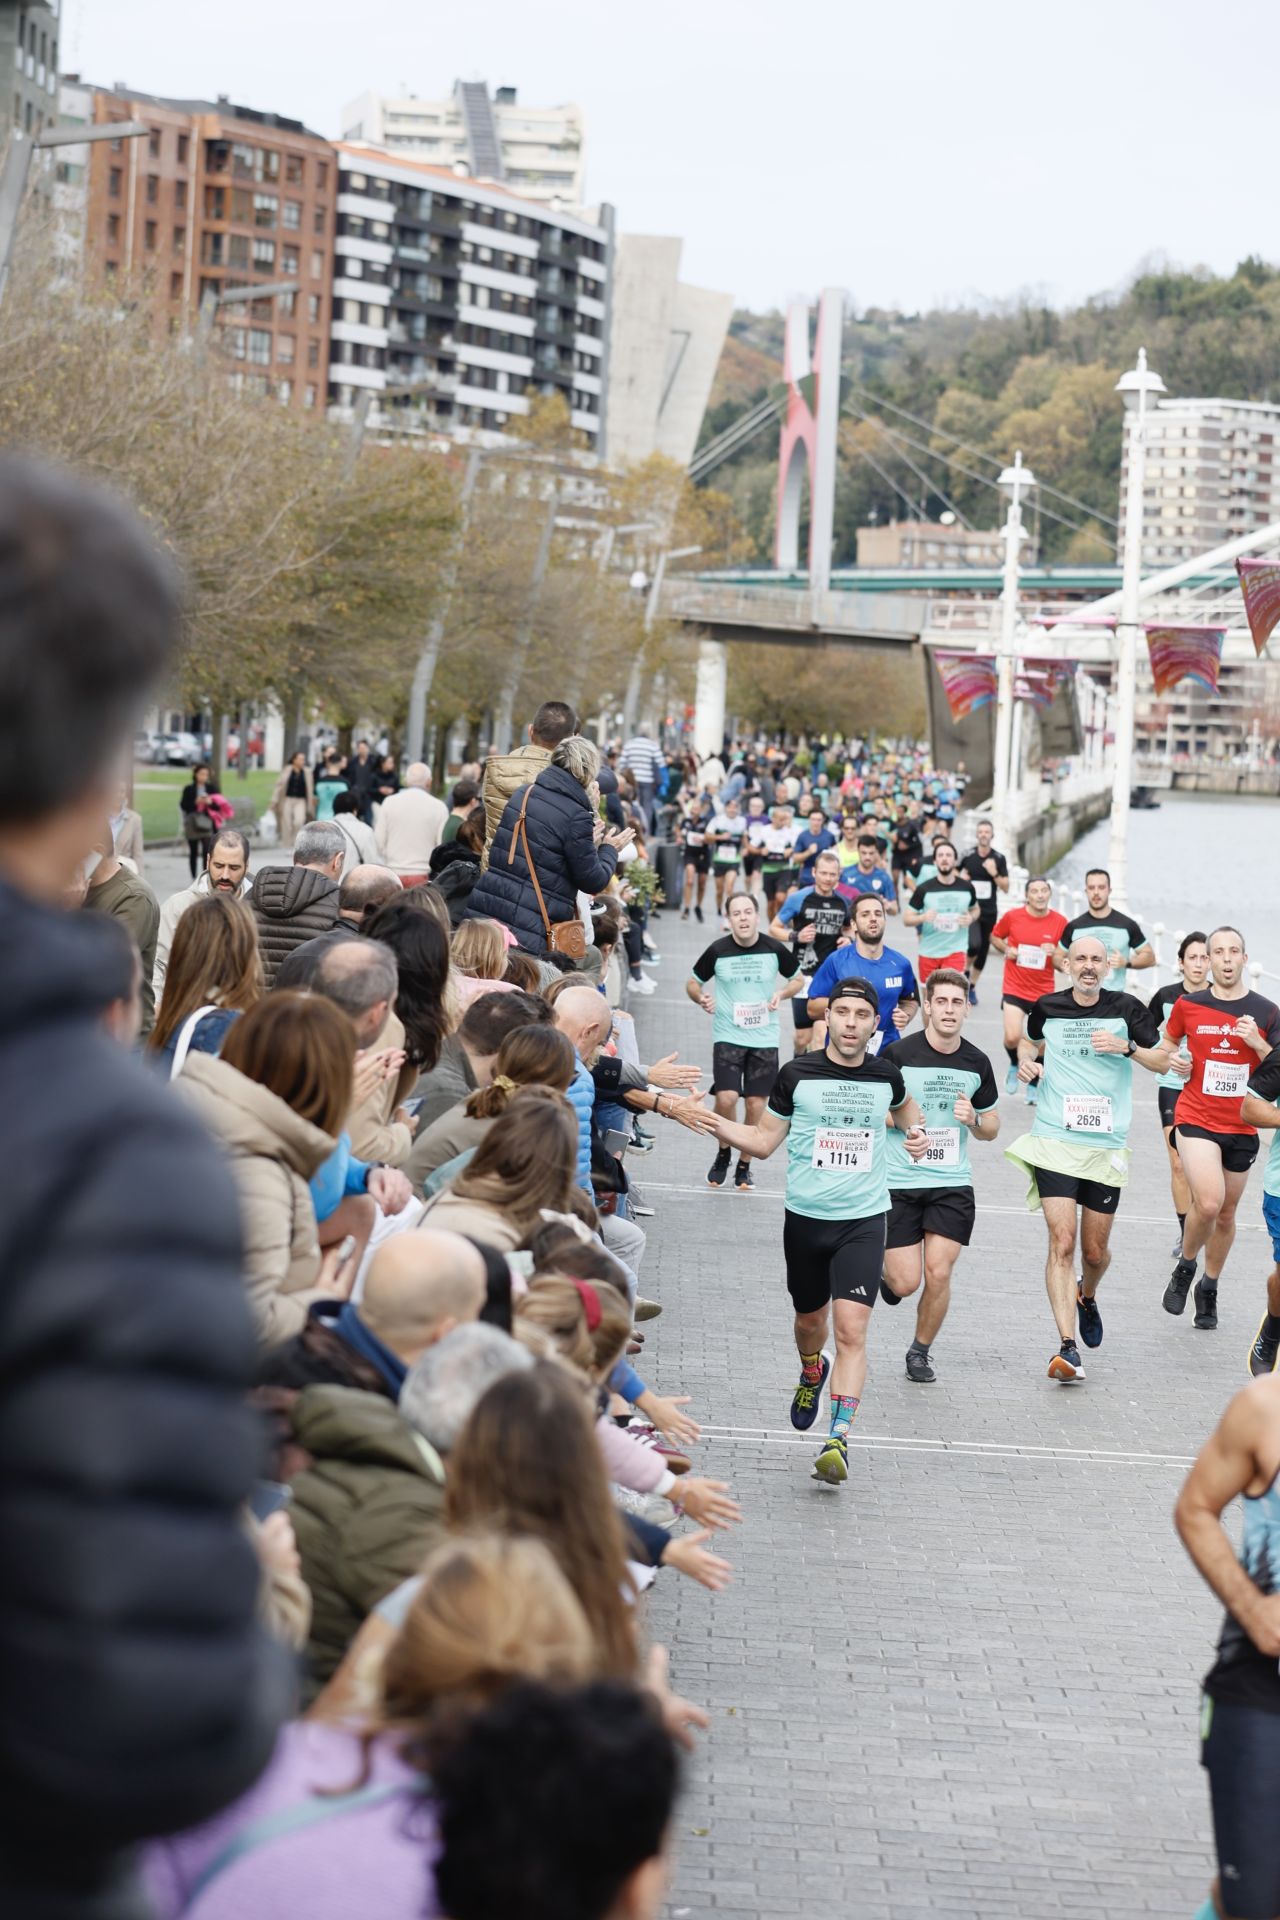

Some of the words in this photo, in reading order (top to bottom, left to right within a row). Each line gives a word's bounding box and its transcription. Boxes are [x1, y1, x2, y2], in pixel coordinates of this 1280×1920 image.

[744, 1016, 761, 1025] 2032
[1210, 1047, 1240, 1055] Santander
[1208, 1071, 1226, 1080] XXXVI
[1214, 1081, 1237, 1092] 2359
[1067, 1104, 1088, 1113] XXXVI
[1077, 1115, 1101, 1126] 2626
[819, 1139, 843, 1150] XXXVI
[830, 1151, 858, 1166] 1114
[926, 1149, 944, 1160] 998
